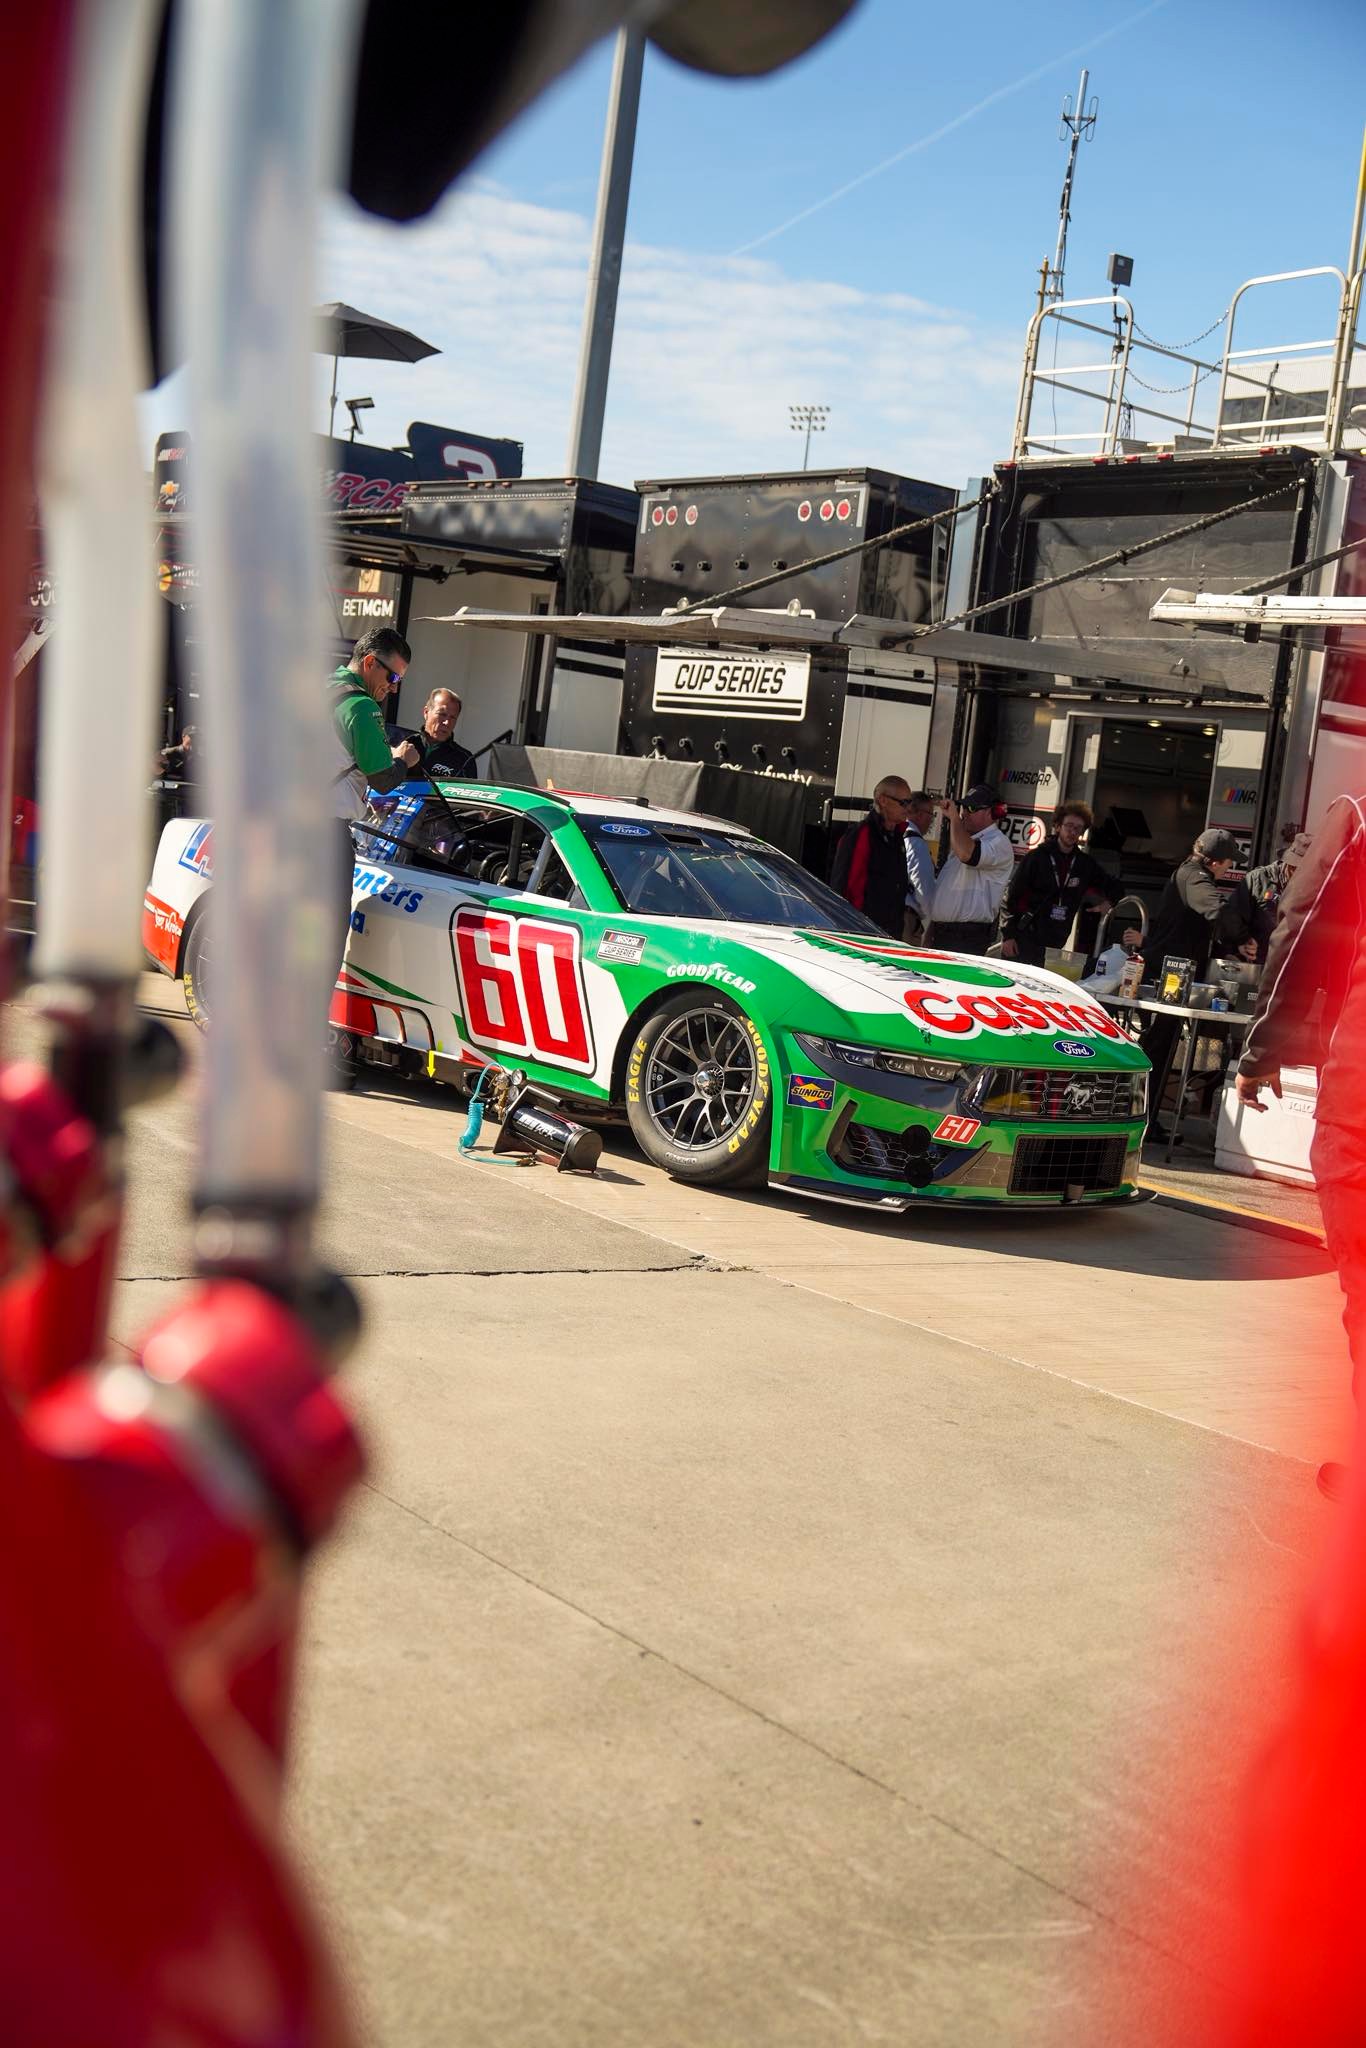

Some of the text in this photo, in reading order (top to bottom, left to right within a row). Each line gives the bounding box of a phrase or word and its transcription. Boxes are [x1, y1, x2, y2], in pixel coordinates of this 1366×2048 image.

[342, 598, 394, 617] BETMGM
[674, 663, 787, 694] CUP SERIES
[1009, 769, 1052, 787] NASCAR
[441, 786, 502, 800] PREECE
[1238, 789, 1257, 805] NA
[611, 824, 642, 836] Ford
[616, 947, 637, 958] SERIES
[666, 963, 757, 994] GOODYEAR
[455, 912, 590, 1064] 60
[1063, 1042, 1090, 1056] Ford
[628, 1036, 648, 1103] EAGLE
[792, 1085, 832, 1100] SUNOCO
[933, 1115, 982, 1144] 60
